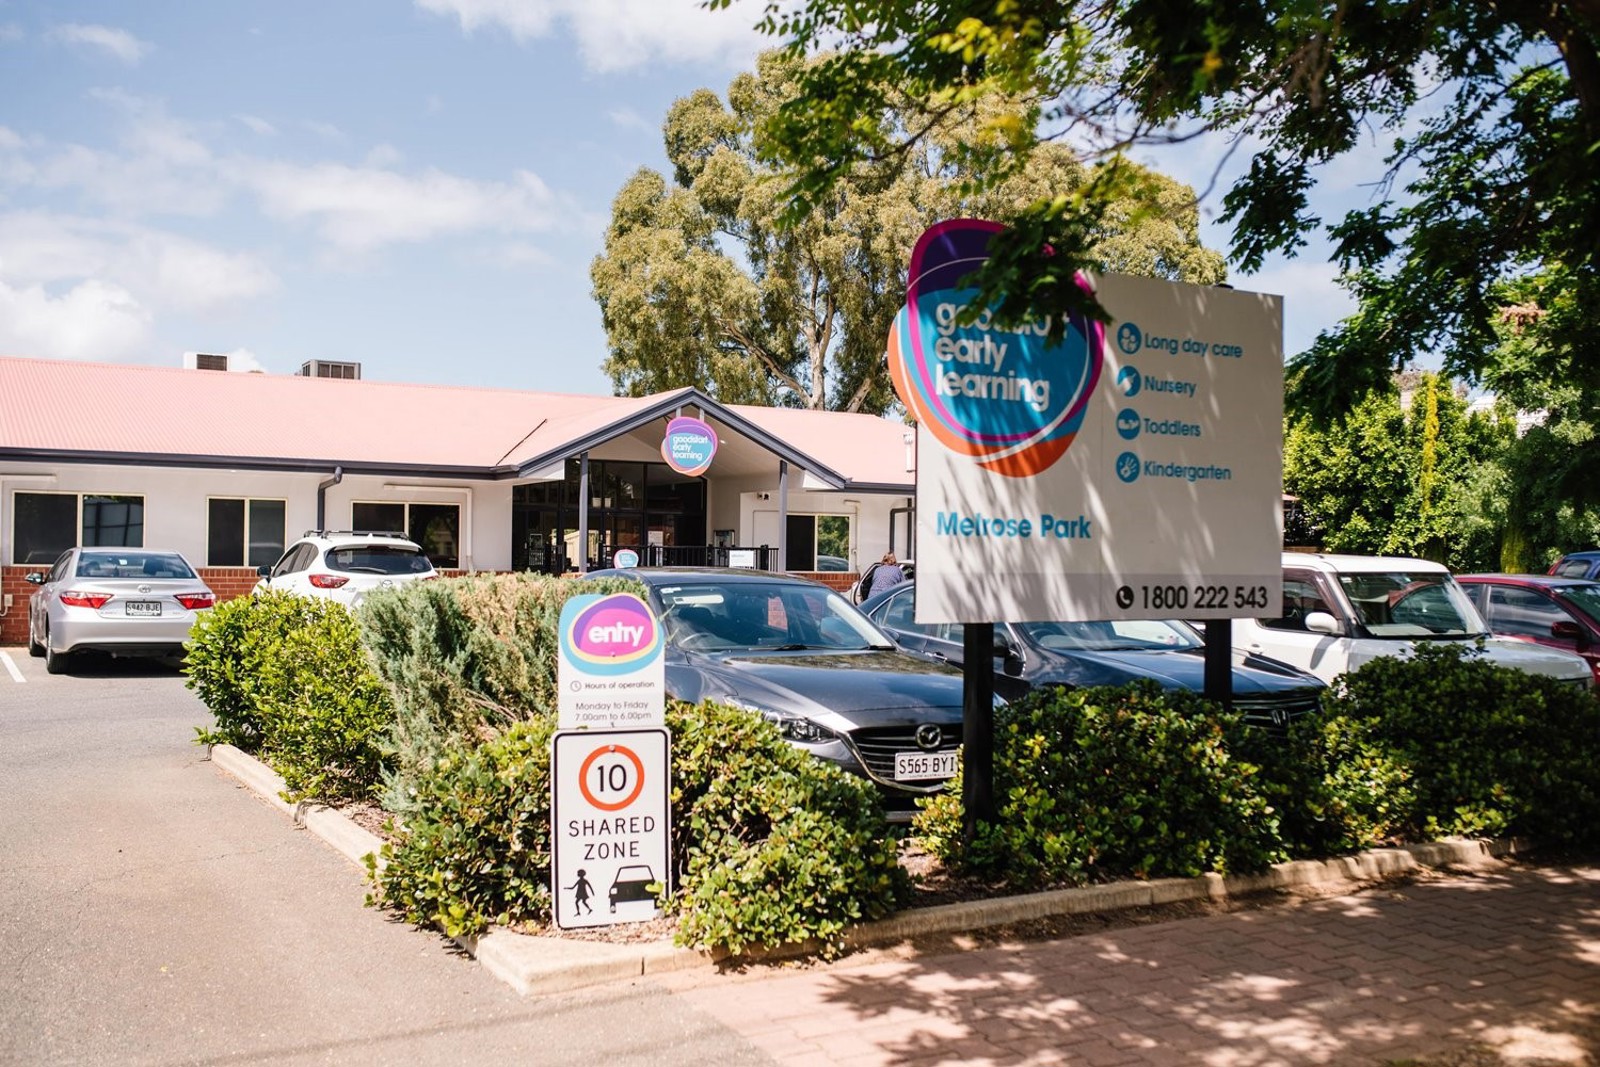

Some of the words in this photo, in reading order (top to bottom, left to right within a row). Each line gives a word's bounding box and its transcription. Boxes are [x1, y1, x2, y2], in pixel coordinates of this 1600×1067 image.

[935, 334, 1008, 372] early
[1145, 333, 1179, 355] Long
[1182, 338, 1208, 357] day
[1212, 343, 1243, 358] care
[935, 363, 1050, 412] learning
[1144, 375, 1197, 397] Nursery
[1144, 418, 1201, 437] Toddlers
[673, 443, 691, 452] early
[673, 451, 702, 461] learning
[1144, 461, 1232, 482] Kindergarten
[936, 511, 1032, 538] Melrose
[1041, 514, 1092, 539] Park
[1142, 586, 1189, 609] 1800
[1194, 587, 1229, 609] 222
[1233, 587, 1269, 609] 543
[588, 621, 644, 647] entry
[585, 682, 607, 690] Hours
[618, 681, 655, 689] operation
[575, 702, 612, 711] Monday
[623, 701, 649, 710] Friday
[609, 713, 619, 721] to
[597, 764, 627, 792] 10
[568, 816, 655, 837] SHARED
[584, 841, 640, 860] ZONE
